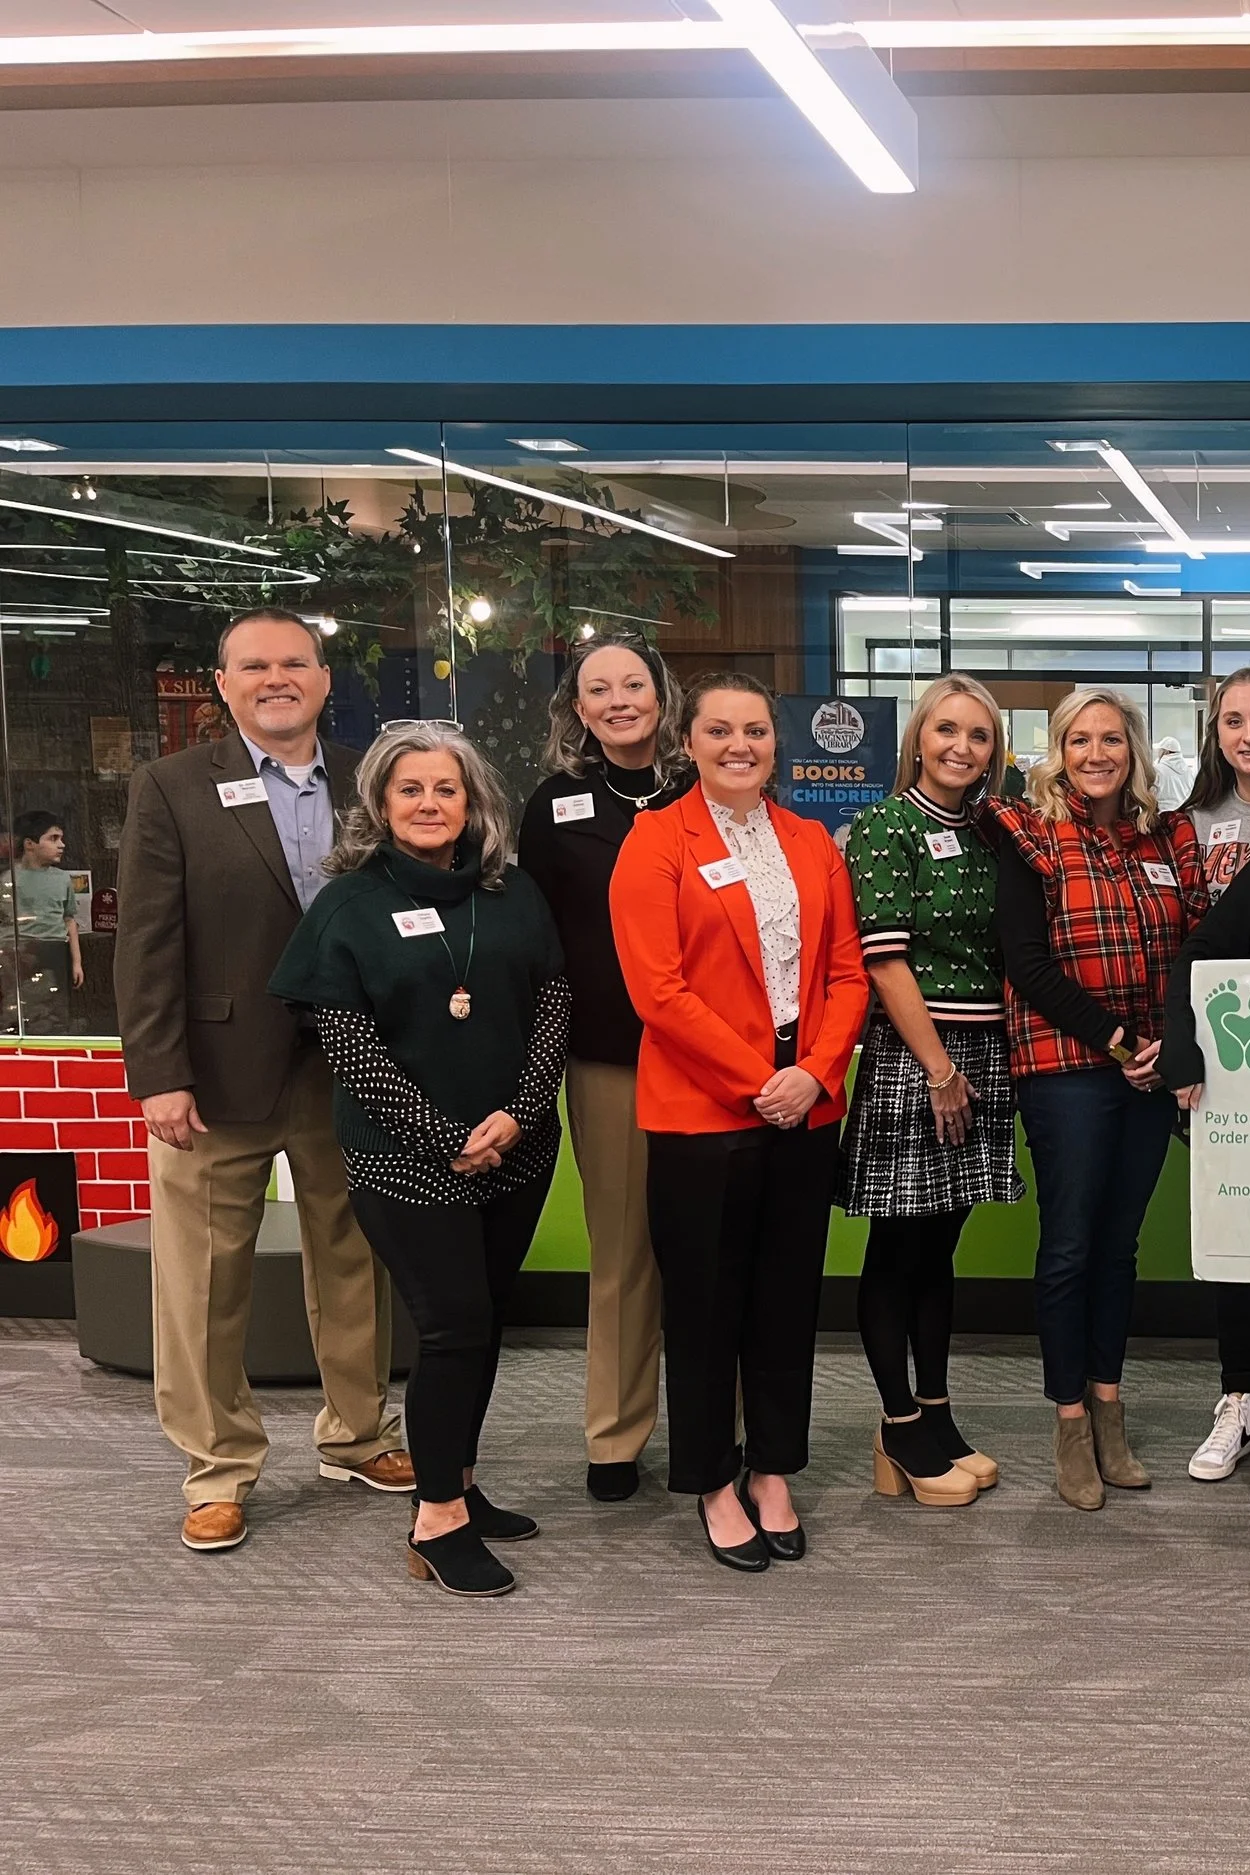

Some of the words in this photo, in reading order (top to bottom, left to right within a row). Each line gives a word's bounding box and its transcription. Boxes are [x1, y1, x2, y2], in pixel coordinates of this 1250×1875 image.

[792, 765, 865, 781] BOOKS
[792, 789, 884, 803] CHILDREN
[1205, 1111, 1229, 1126] Pay
[1234, 1112, 1249, 1124] to
[1208, 1130, 1249, 1144] Order
